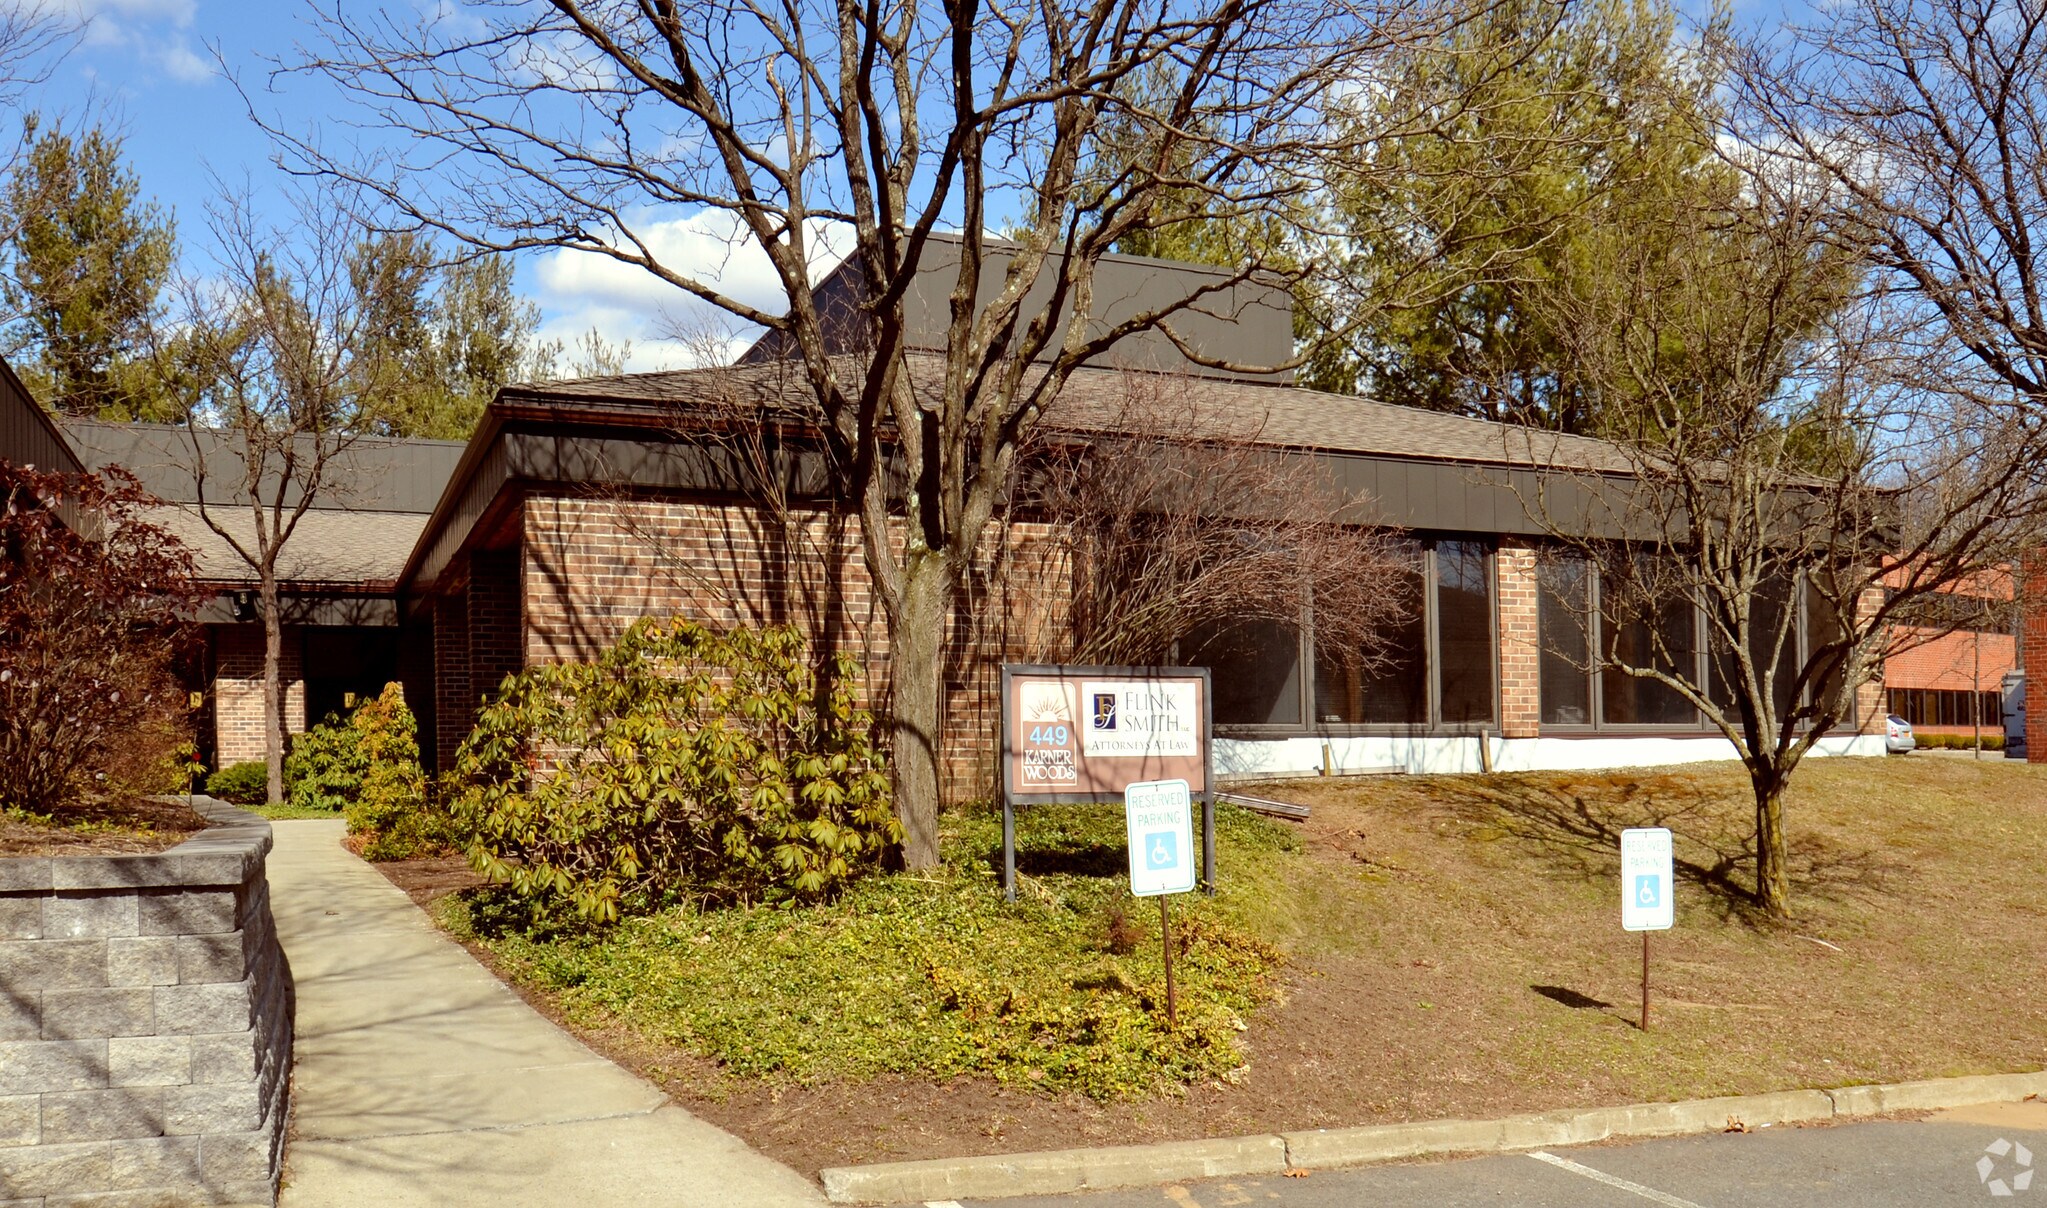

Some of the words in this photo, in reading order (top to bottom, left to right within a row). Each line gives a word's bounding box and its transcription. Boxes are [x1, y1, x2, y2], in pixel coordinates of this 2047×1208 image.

[1126, 692, 1176, 710] FLINK
[1125, 714, 1178, 732] SMITH
[1029, 725, 1068, 746] 449
[1092, 740, 1150, 750] ATTORNEYS
[1154, 740, 1166, 750] AT
[1170, 739, 1189, 750] LAW
[1024, 749, 1073, 765] KARNER
[1023, 765, 1075, 780] WOODS
[1132, 791, 1184, 809] RESERVED
[1138, 811, 1181, 827] PARKING
